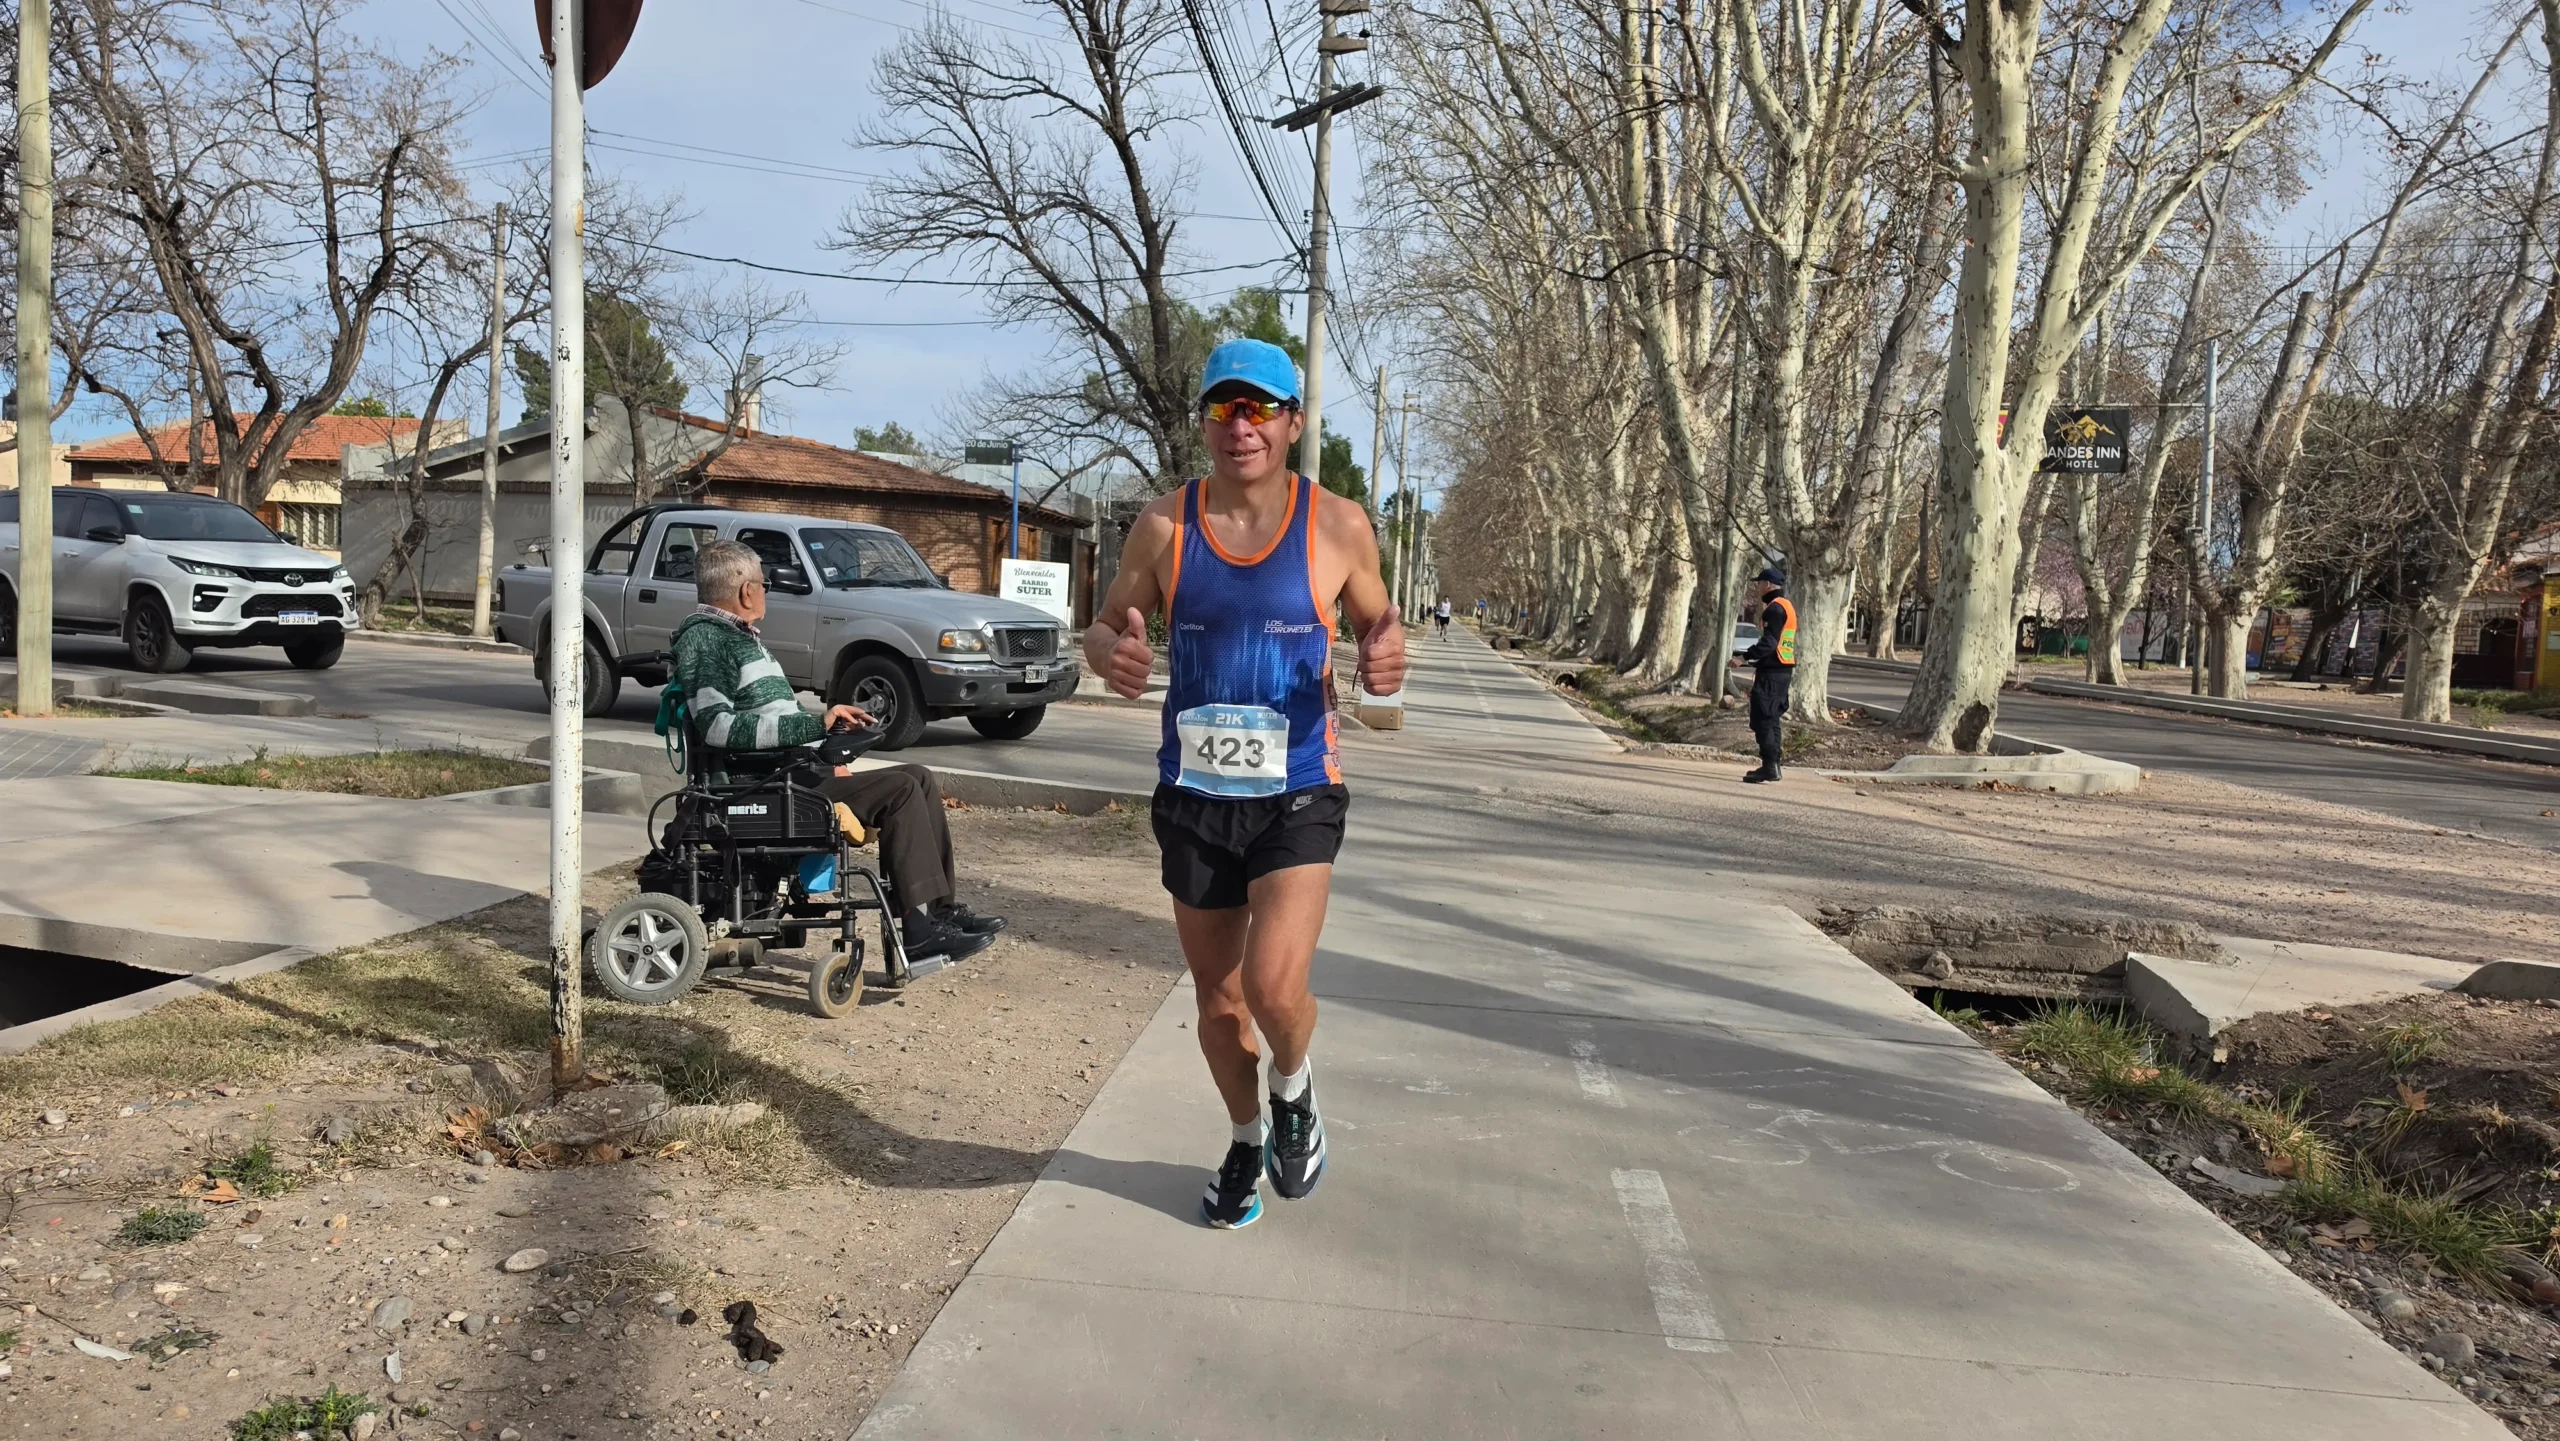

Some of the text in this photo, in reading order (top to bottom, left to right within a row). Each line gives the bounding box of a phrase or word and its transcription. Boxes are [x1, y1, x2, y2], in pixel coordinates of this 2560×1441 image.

[966, 440, 1009, 449] 20 de Junio
[2047, 446, 2120, 459] ANDES INN
[2066, 460, 2100, 469] HOTEL
[1013, 567, 1056, 579] Bienvenidos
[1021, 579, 1049, 587] BARRIO
[1016, 585, 1052, 596] SUTER
[1179, 622, 1205, 631] Carlitos
[1265, 619, 1284, 627] LOS
[1215, 712, 1245, 725] 21K
[1197, 735, 1266, 769] 423
[1295, 794, 1313, 805] NIKE
